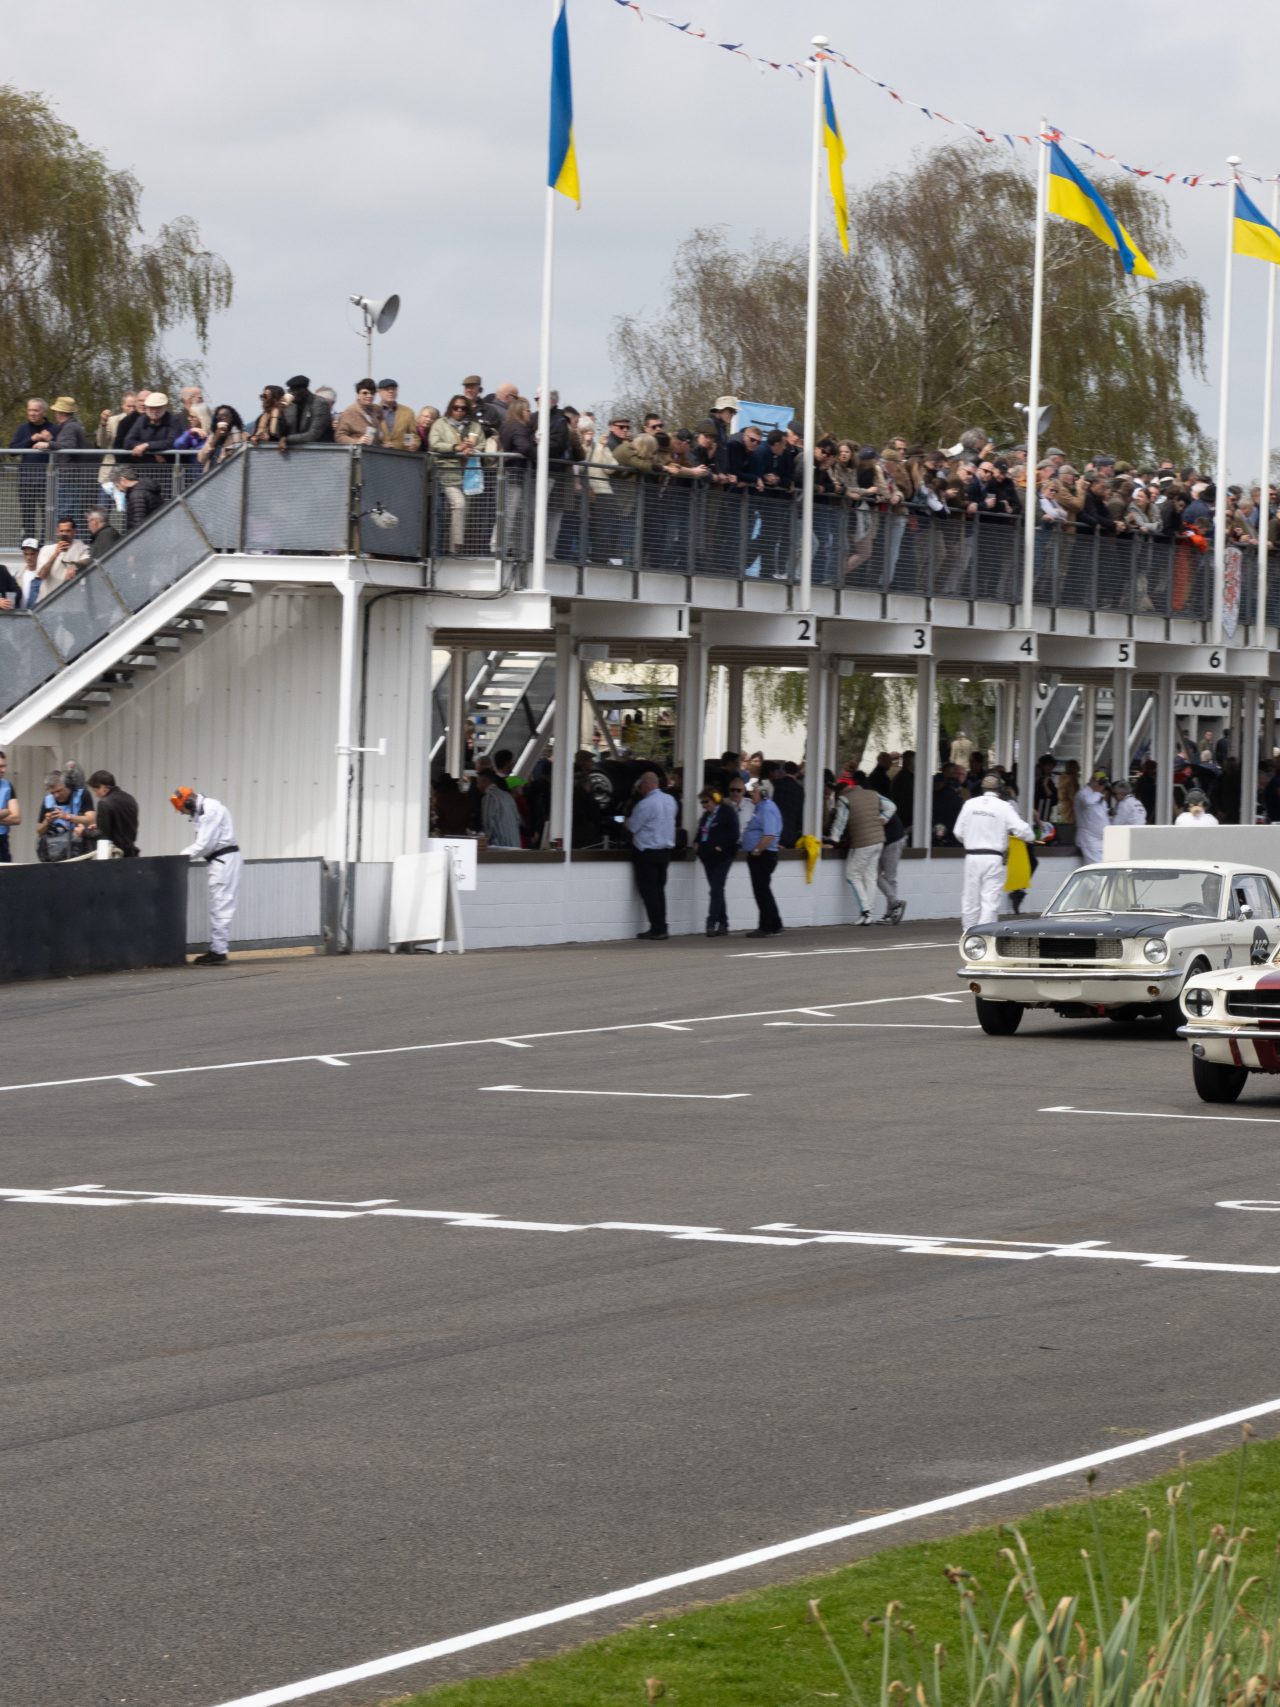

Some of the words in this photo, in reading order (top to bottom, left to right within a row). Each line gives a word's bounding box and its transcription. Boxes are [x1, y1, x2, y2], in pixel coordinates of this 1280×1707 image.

[677, 609, 684, 632] 1
[796, 619, 811, 641] 2
[913, 629, 926, 649] 3
[1019, 636, 1034, 656] 4
[1118, 643, 1130, 662] 5
[1209, 650, 1221, 668] 6
